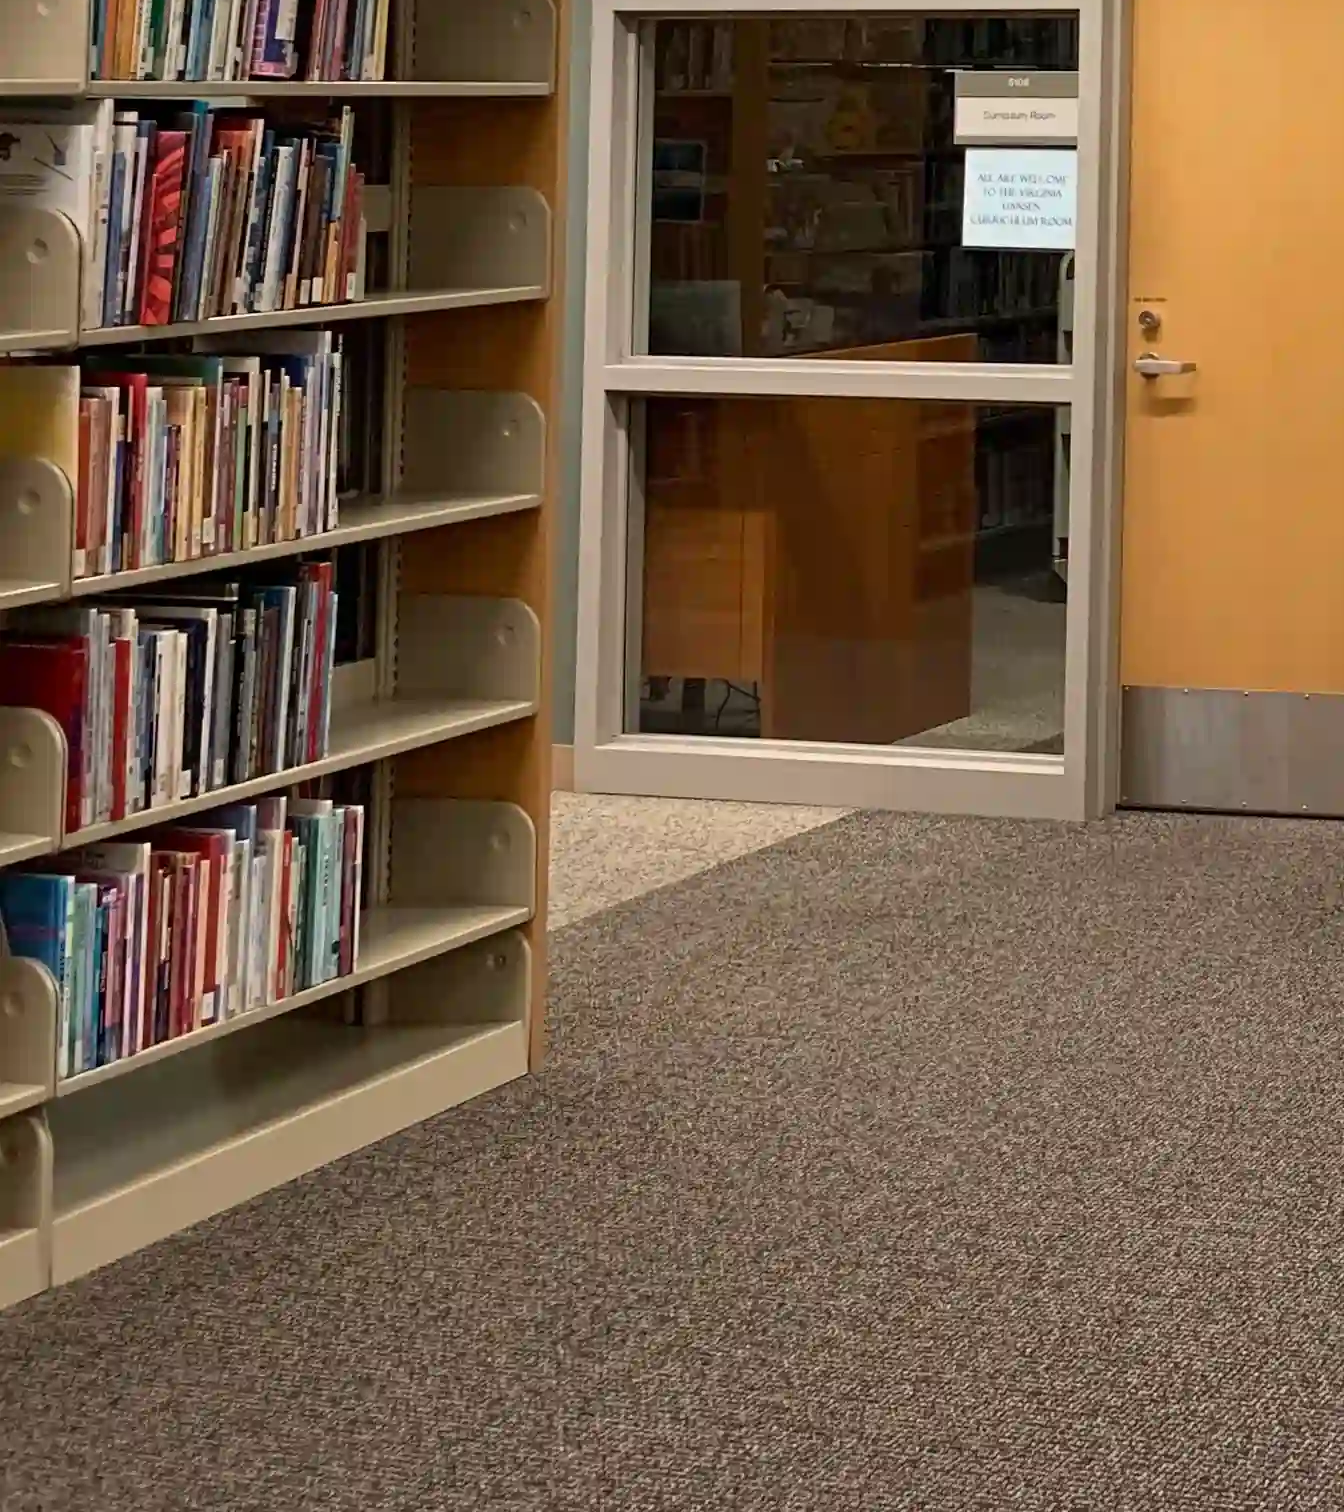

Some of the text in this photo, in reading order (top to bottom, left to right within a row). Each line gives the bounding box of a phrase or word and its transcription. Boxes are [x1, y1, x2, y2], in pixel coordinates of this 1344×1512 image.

[977, 173, 1068, 184] ALL ARE WELCOME
[982, 187, 1063, 199] TO THE VIRGINIA
[1002, 201, 1041, 211] HANSEN
[969, 214, 1073, 227] CURRICULUM ROOM
